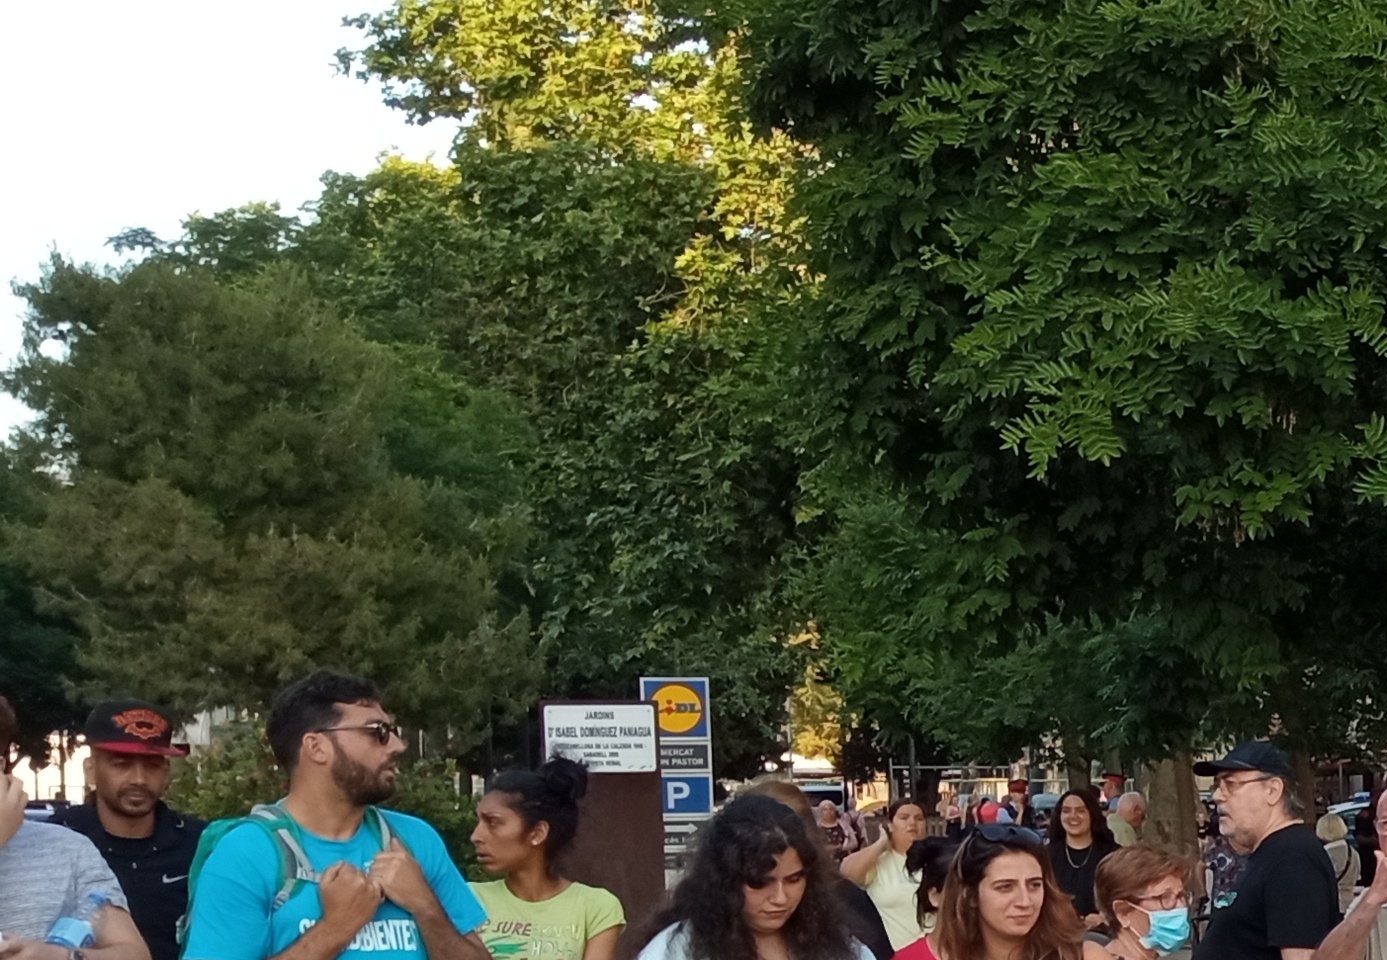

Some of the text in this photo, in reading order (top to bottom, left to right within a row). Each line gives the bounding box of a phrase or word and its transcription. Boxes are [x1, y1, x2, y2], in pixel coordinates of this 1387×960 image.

[584, 711, 615, 720] JARDINS
[555, 726, 578, 738] ISABEL
[620, 726, 652, 737] PANIAGUA
[671, 757, 704, 766] PASTOR
[666, 781, 691, 810] P
[492, 920, 532, 936] SURE
